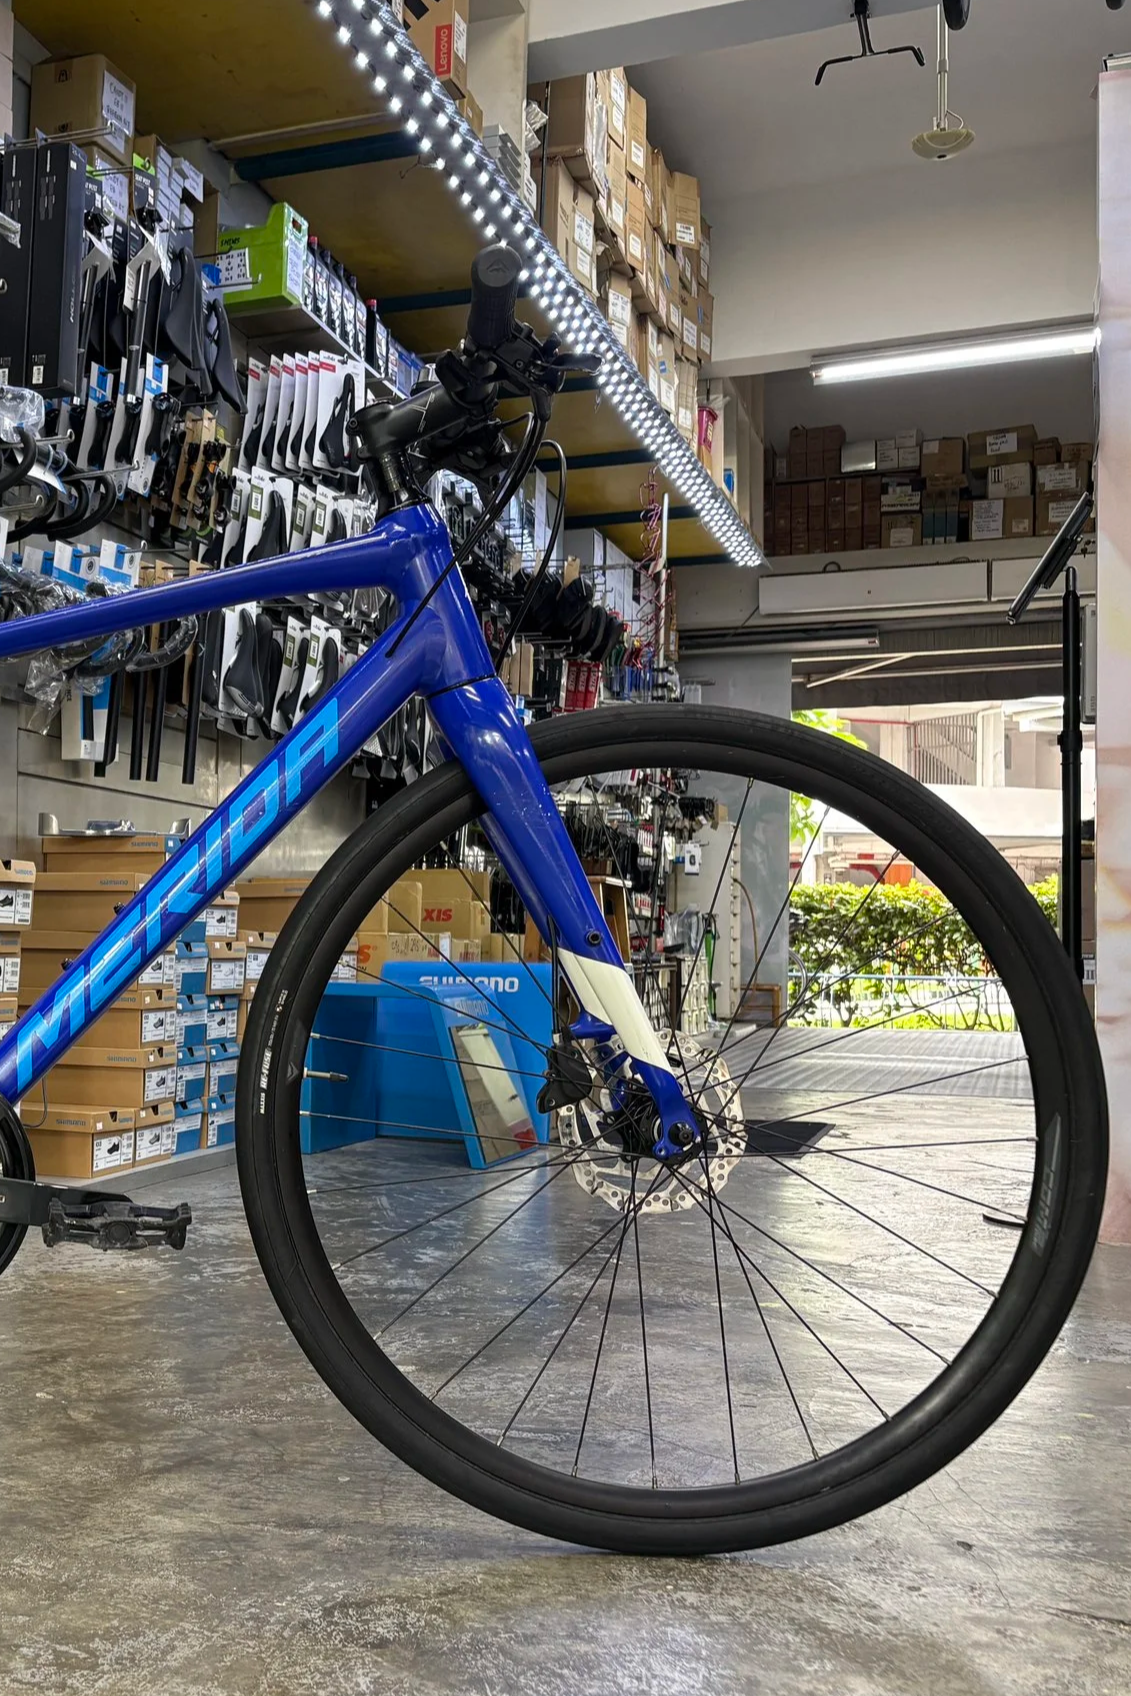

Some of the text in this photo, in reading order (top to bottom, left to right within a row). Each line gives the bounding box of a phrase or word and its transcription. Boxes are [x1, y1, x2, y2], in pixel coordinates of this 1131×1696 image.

[438, 28, 449, 72] Lenovo
[17, 697, 338, 1092] MERIDA
[422, 908, 453, 923] XIS
